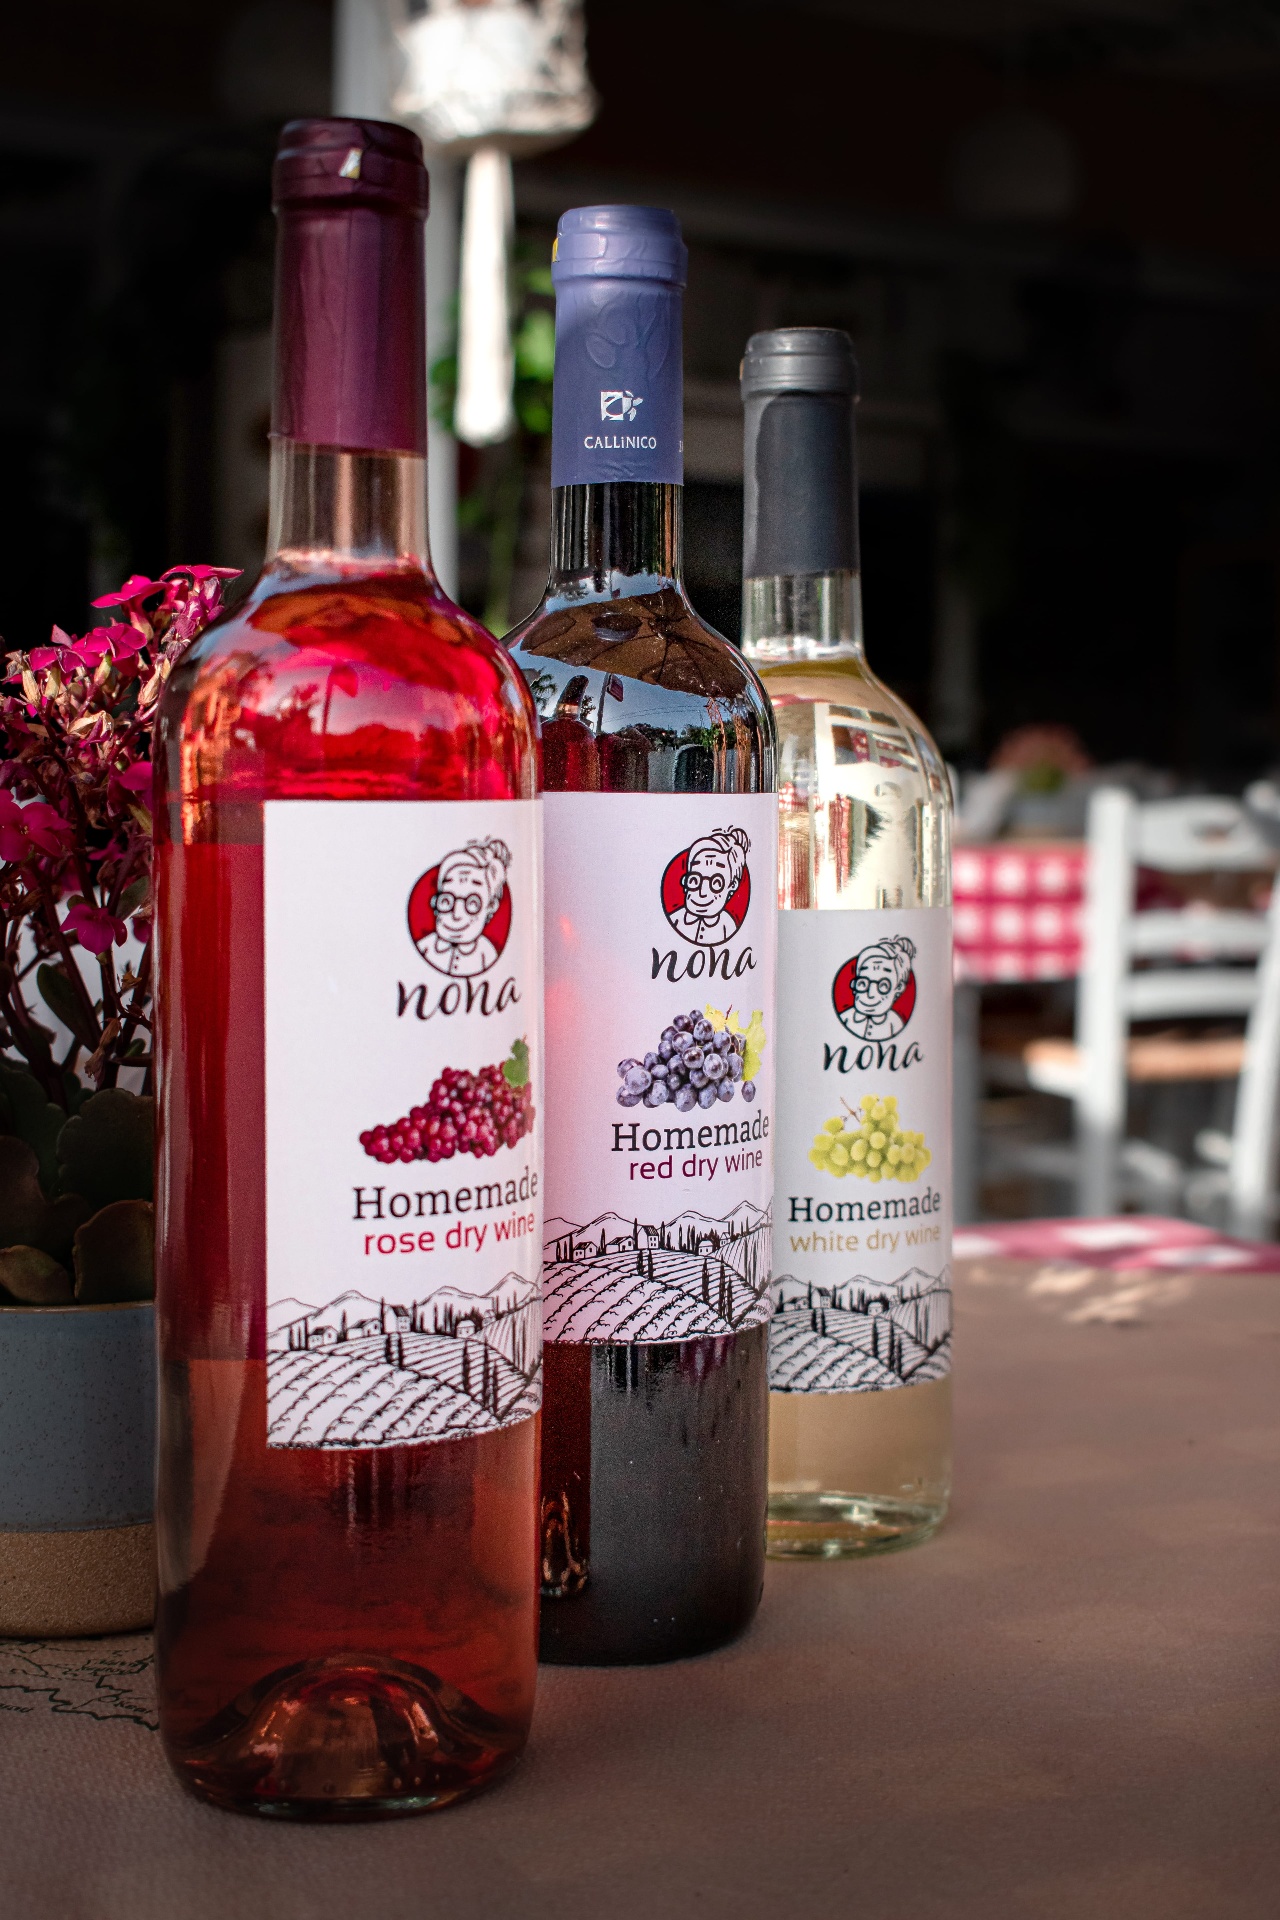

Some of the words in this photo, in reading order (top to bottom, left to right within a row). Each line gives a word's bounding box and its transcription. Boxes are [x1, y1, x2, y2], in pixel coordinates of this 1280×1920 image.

[652, 946, 757, 983] nona
[397, 976, 522, 1020] nona
[823, 1041, 923, 1074] nona
[611, 1110, 769, 1152] Homemade
[630, 1155, 673, 1180] red
[682, 1154, 718, 1181] dry
[725, 1148, 763, 1173] wine
[352, 1165, 538, 1219] Homemade
[788, 1186, 941, 1222] Homemade
[364, 1231, 435, 1256] rose
[446, 1221, 488, 1252] dry
[494, 1211, 535, 1242] wine
[790, 1231, 859, 1254] white
[866, 1229, 900, 1254] dry
[905, 1224, 941, 1246] wine
